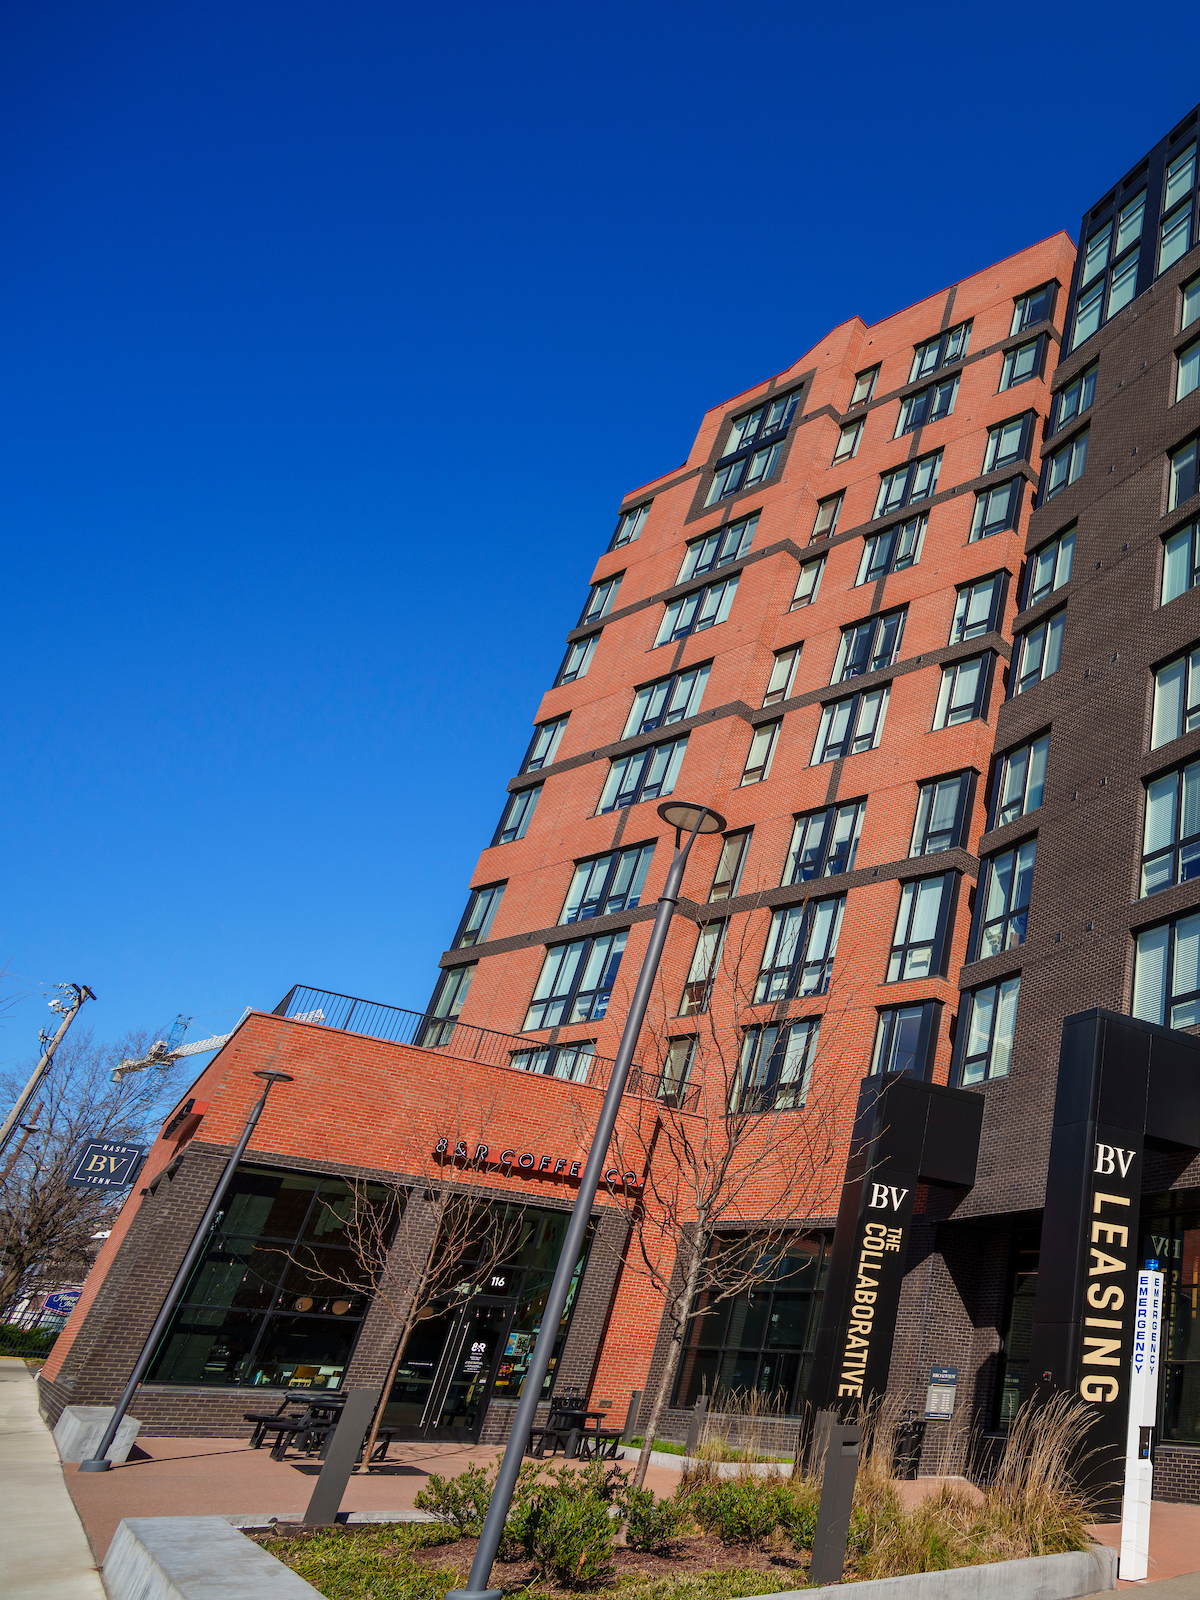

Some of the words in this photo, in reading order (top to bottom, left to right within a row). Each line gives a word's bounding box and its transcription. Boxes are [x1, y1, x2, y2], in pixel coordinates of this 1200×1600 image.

[102, 1145, 127, 1153] NASH
[1093, 1142, 1136, 1179] BV
[85, 1154, 128, 1173] BV
[501, 1150, 582, 1177] COFFE
[87, 1176, 111, 1185] TENN
[868, 1182, 909, 1212] BV
[885, 1227, 903, 1253] THE
[491, 1276, 505, 1287] 116
[837, 1222, 888, 1399] COLLABORATIVE
[1080, 1191, 1131, 1403] LEASING
[1134, 1276, 1149, 1374] EMERGENCY
[1149, 1277, 1160, 1375] EMERGENCY
